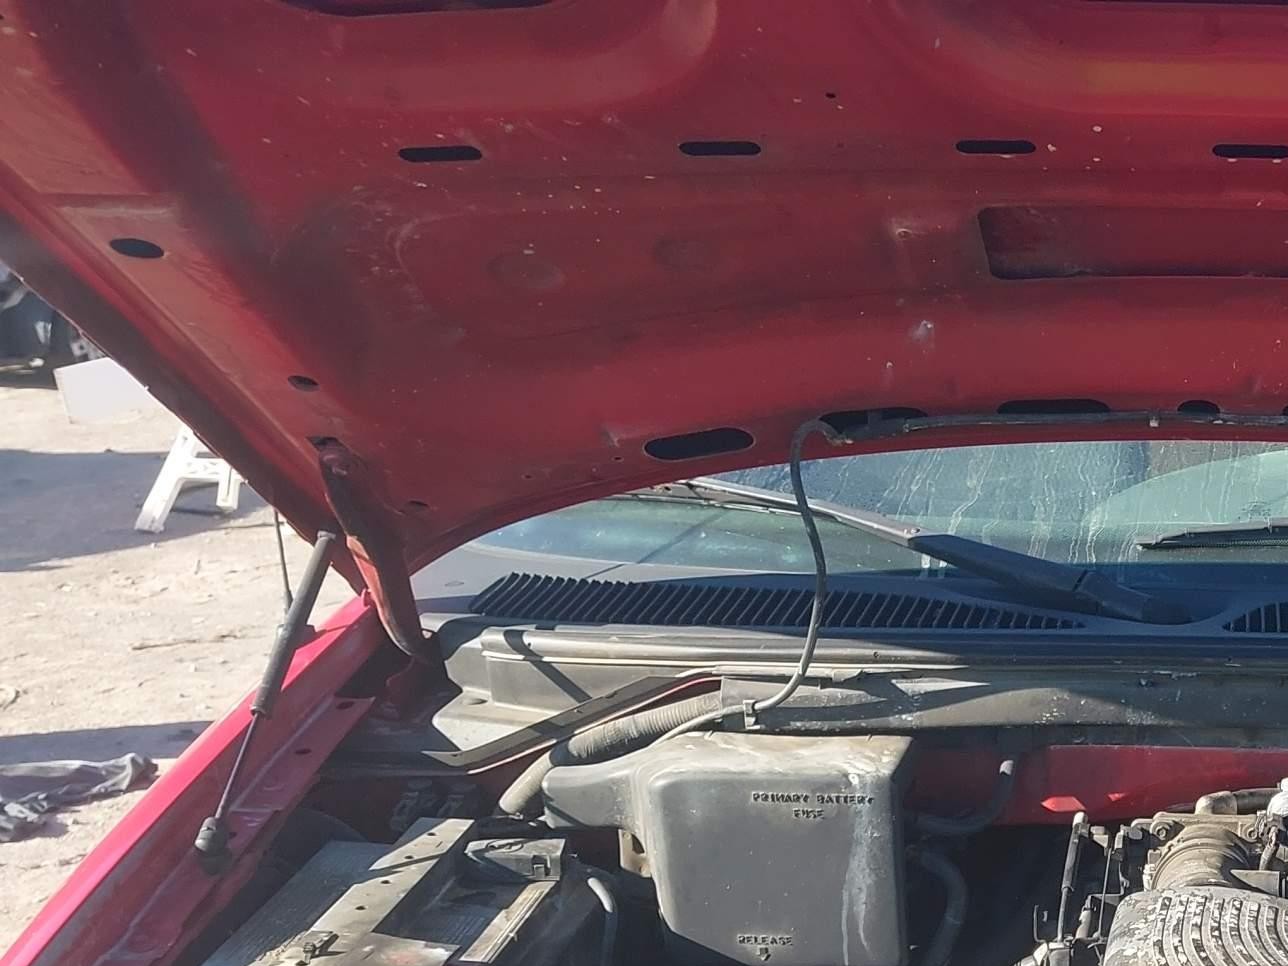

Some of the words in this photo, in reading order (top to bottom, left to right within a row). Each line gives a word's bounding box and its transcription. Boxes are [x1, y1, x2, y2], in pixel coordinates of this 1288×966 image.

[752, 792, 810, 804] PRIMARY
[817, 794, 875, 805] BATTERY
[793, 809, 825, 820] FUSE
[737, 934, 793, 946] RELEASE
